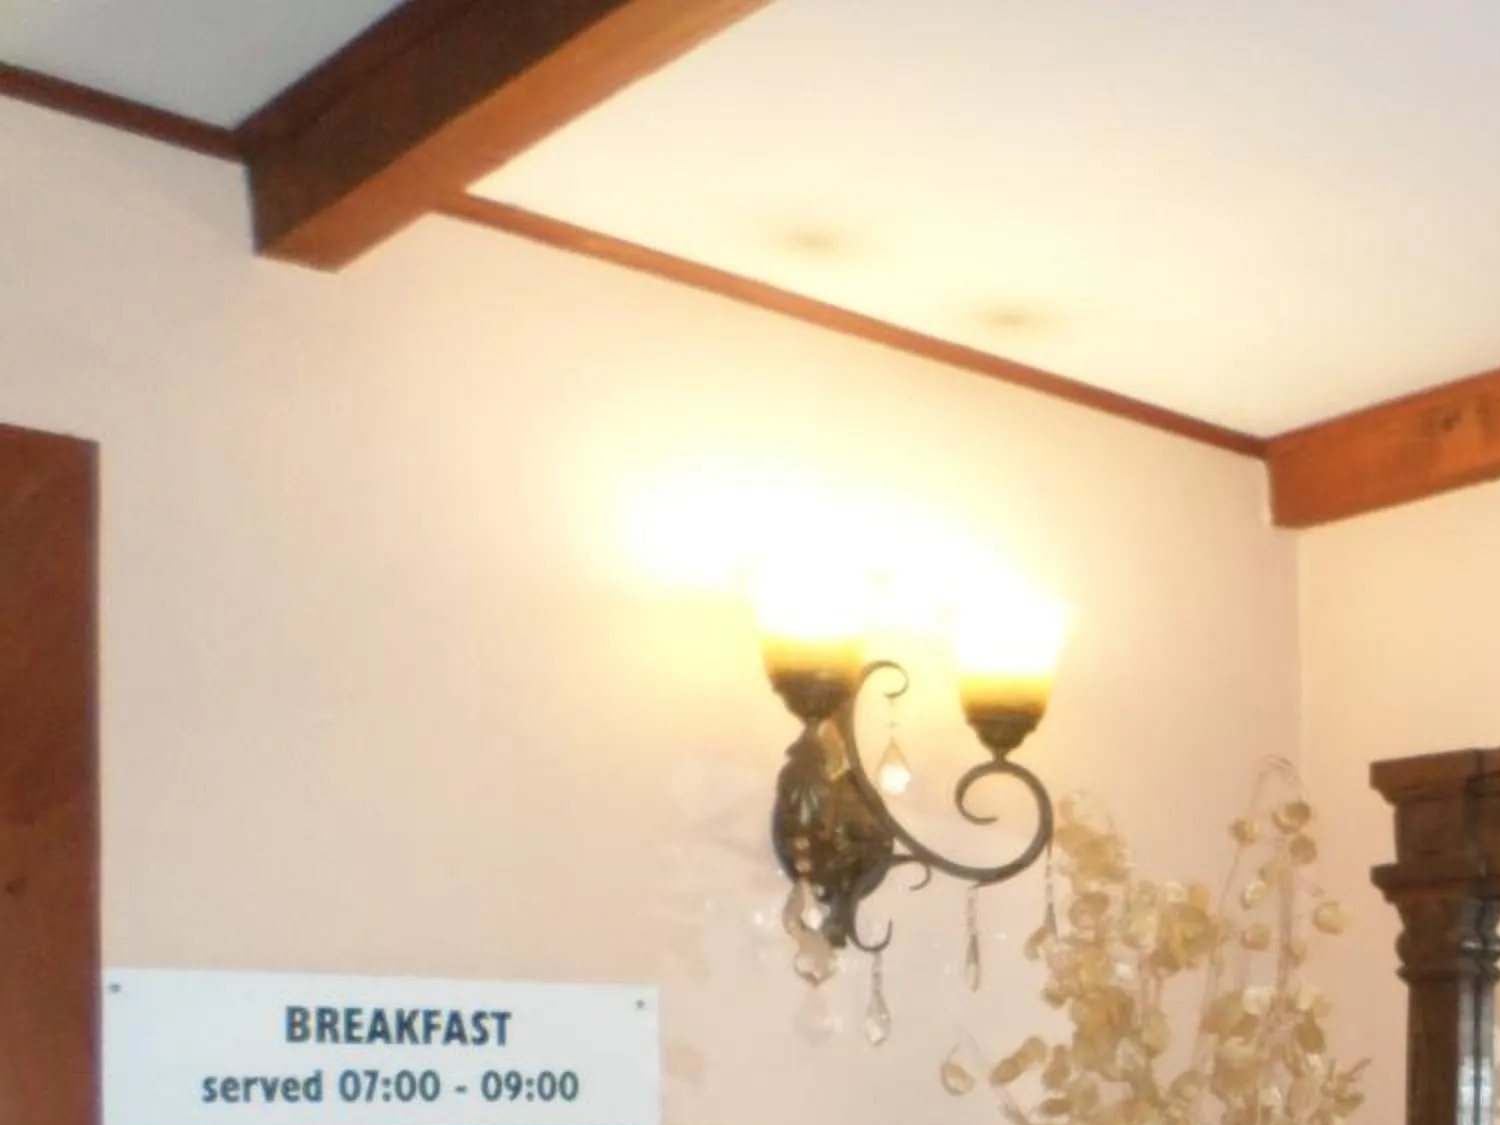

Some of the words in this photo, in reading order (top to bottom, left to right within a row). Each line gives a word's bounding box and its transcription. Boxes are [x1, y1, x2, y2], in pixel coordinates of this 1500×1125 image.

[285, 1005, 512, 1047] BREAKFAST
[202, 1070, 323, 1103] served
[338, 1069, 442, 1102] 07:00
[480, 1070, 580, 1102] 09:00
